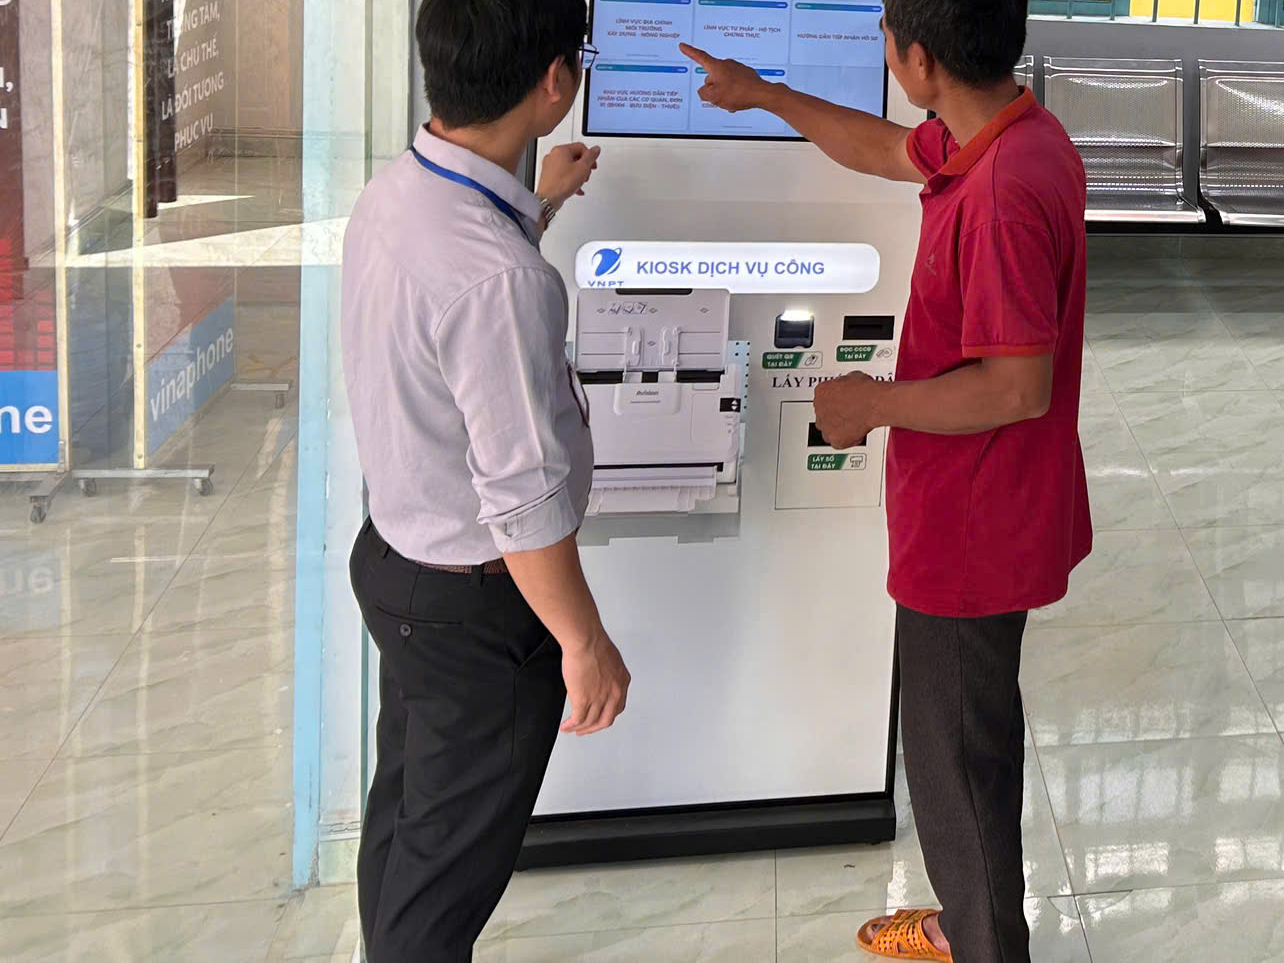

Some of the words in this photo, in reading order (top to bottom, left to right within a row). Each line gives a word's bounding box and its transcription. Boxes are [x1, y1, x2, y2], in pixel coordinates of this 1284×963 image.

[636, 261, 692, 275] KIOSK
[698, 261, 740, 277] DỊCH
[745, 261, 769, 277] VỤ
[774, 258, 825, 275] CÔNG
[150, 327, 234, 421] vinaphone
[771, 374, 805, 388] LẤY
